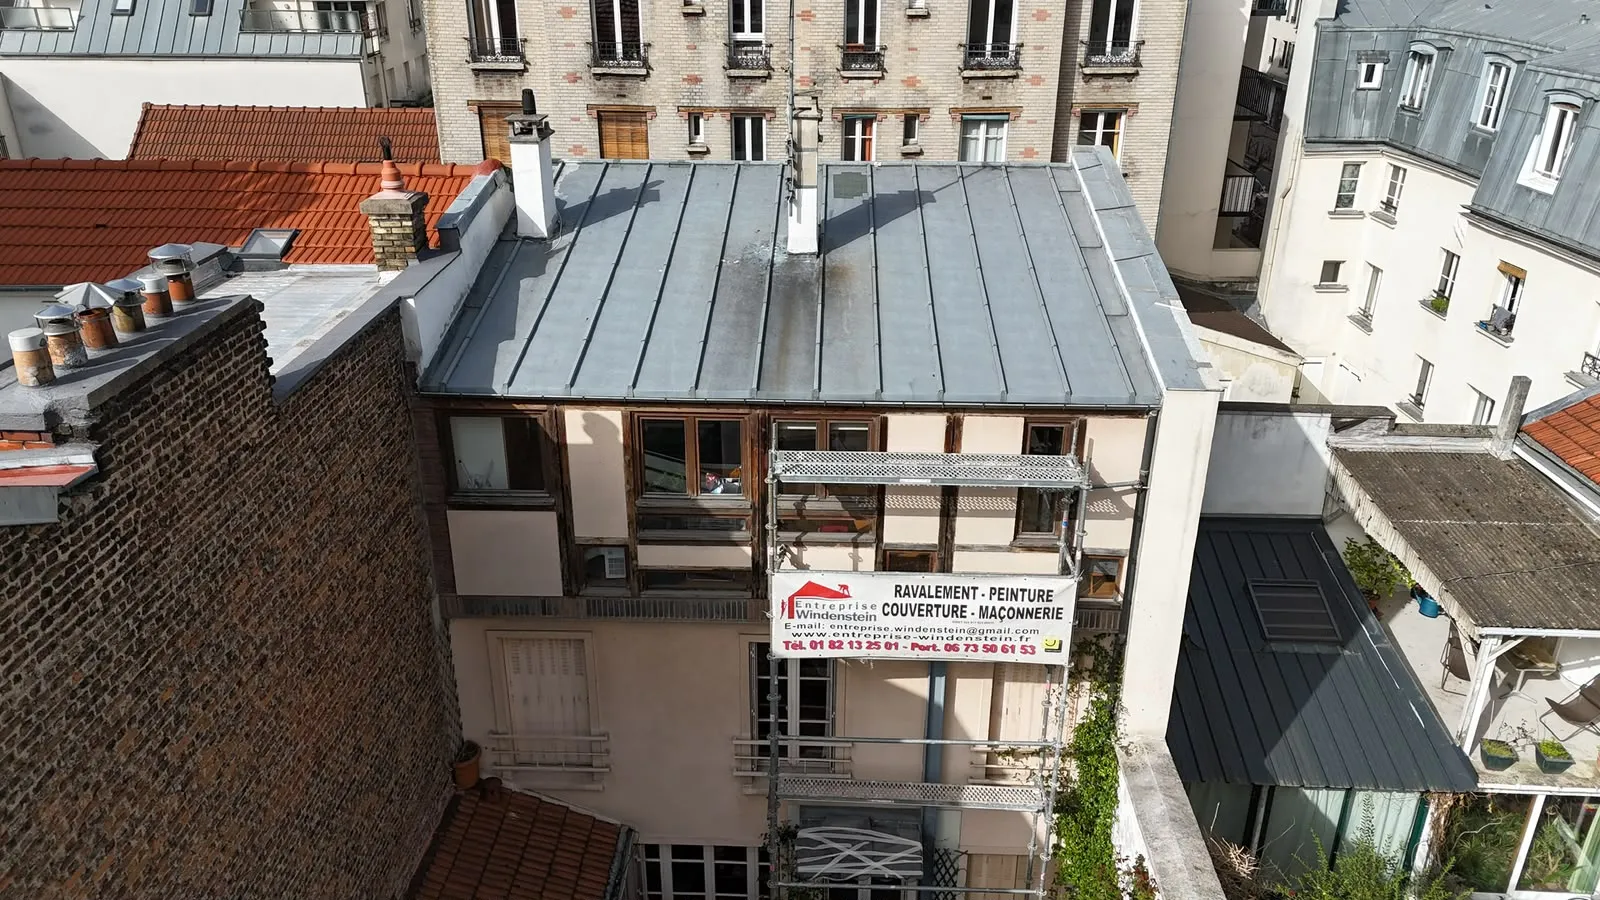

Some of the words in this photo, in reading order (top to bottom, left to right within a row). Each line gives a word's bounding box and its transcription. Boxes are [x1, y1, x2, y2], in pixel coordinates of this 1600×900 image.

[894, 584, 978, 600] RAVALEMENT
[989, 586, 1054, 602] PEINTURE
[795, 600, 877, 610] Entreprise
[795, 610, 877, 622] Windenstein
[882, 602, 967, 618] COUVERTURE
[979, 605, 1064, 622] MAÇONNERIE
[784, 622, 825, 630] E-mail:
[830, 623, 1039, 635] entreprise.windenstein@gmail.com
[792, 632, 1031, 642] www.entreprise-windenstein.fr
[782, 640, 806, 650] Tél.
[809, 640, 824, 650] 01
[828, 640, 844, 650] 82
[847, 640, 862, 650] 13
[866, 640, 881, 650] 25
[884, 641, 899, 651] 01
[910, 642, 940, 652] Port.
[944, 643, 960, 652] 06
[963, 643, 978, 653] 73
[982, 644, 998, 654] 50
[1001, 644, 1016, 654] 61
[1020, 645, 1036, 655] 53
